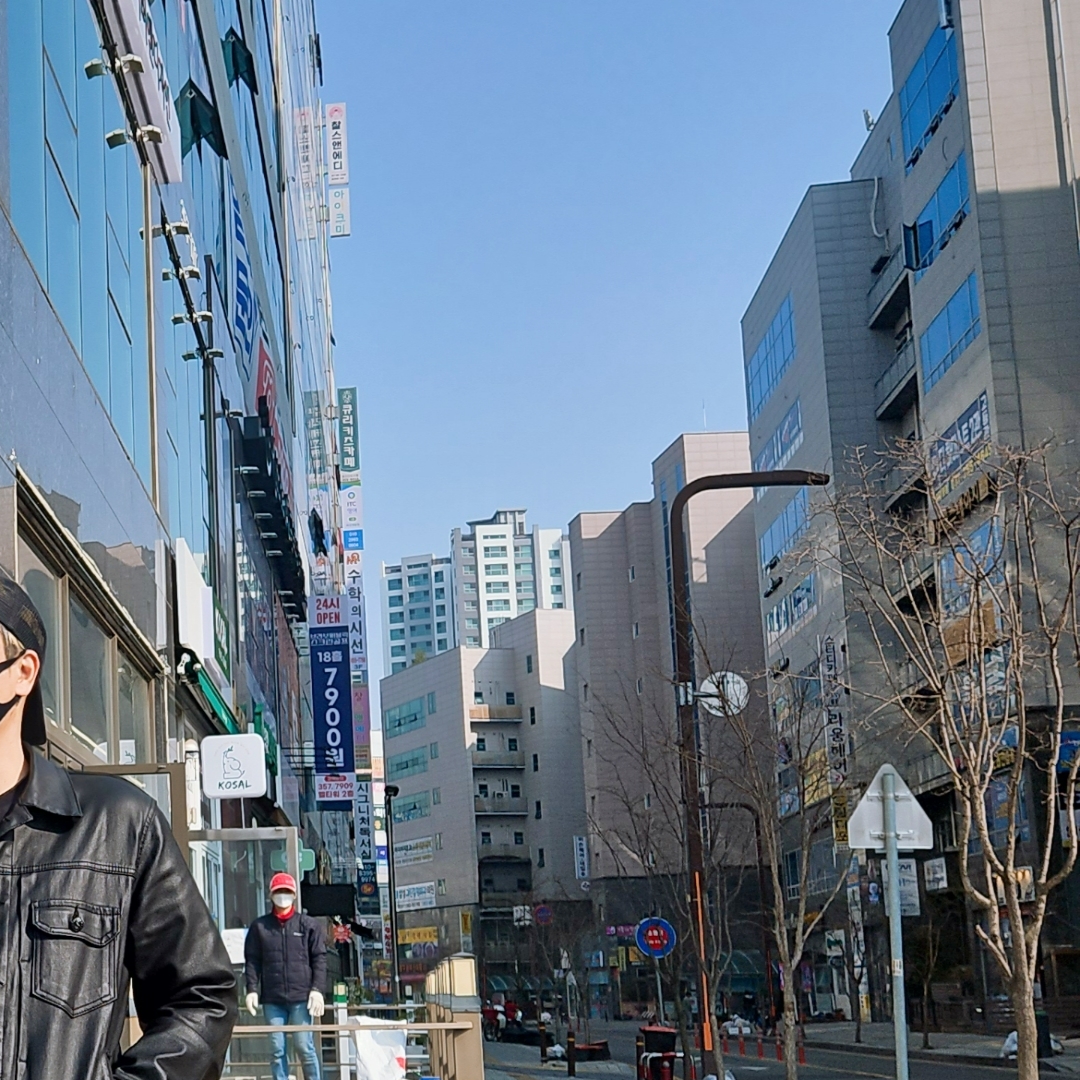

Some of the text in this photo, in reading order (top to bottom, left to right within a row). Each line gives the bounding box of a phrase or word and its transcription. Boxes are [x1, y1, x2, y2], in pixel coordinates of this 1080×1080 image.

[316, 598, 340, 611] 24시
[316, 612, 340, 624] OPEN
[218, 780, 252, 790] KOSAL
